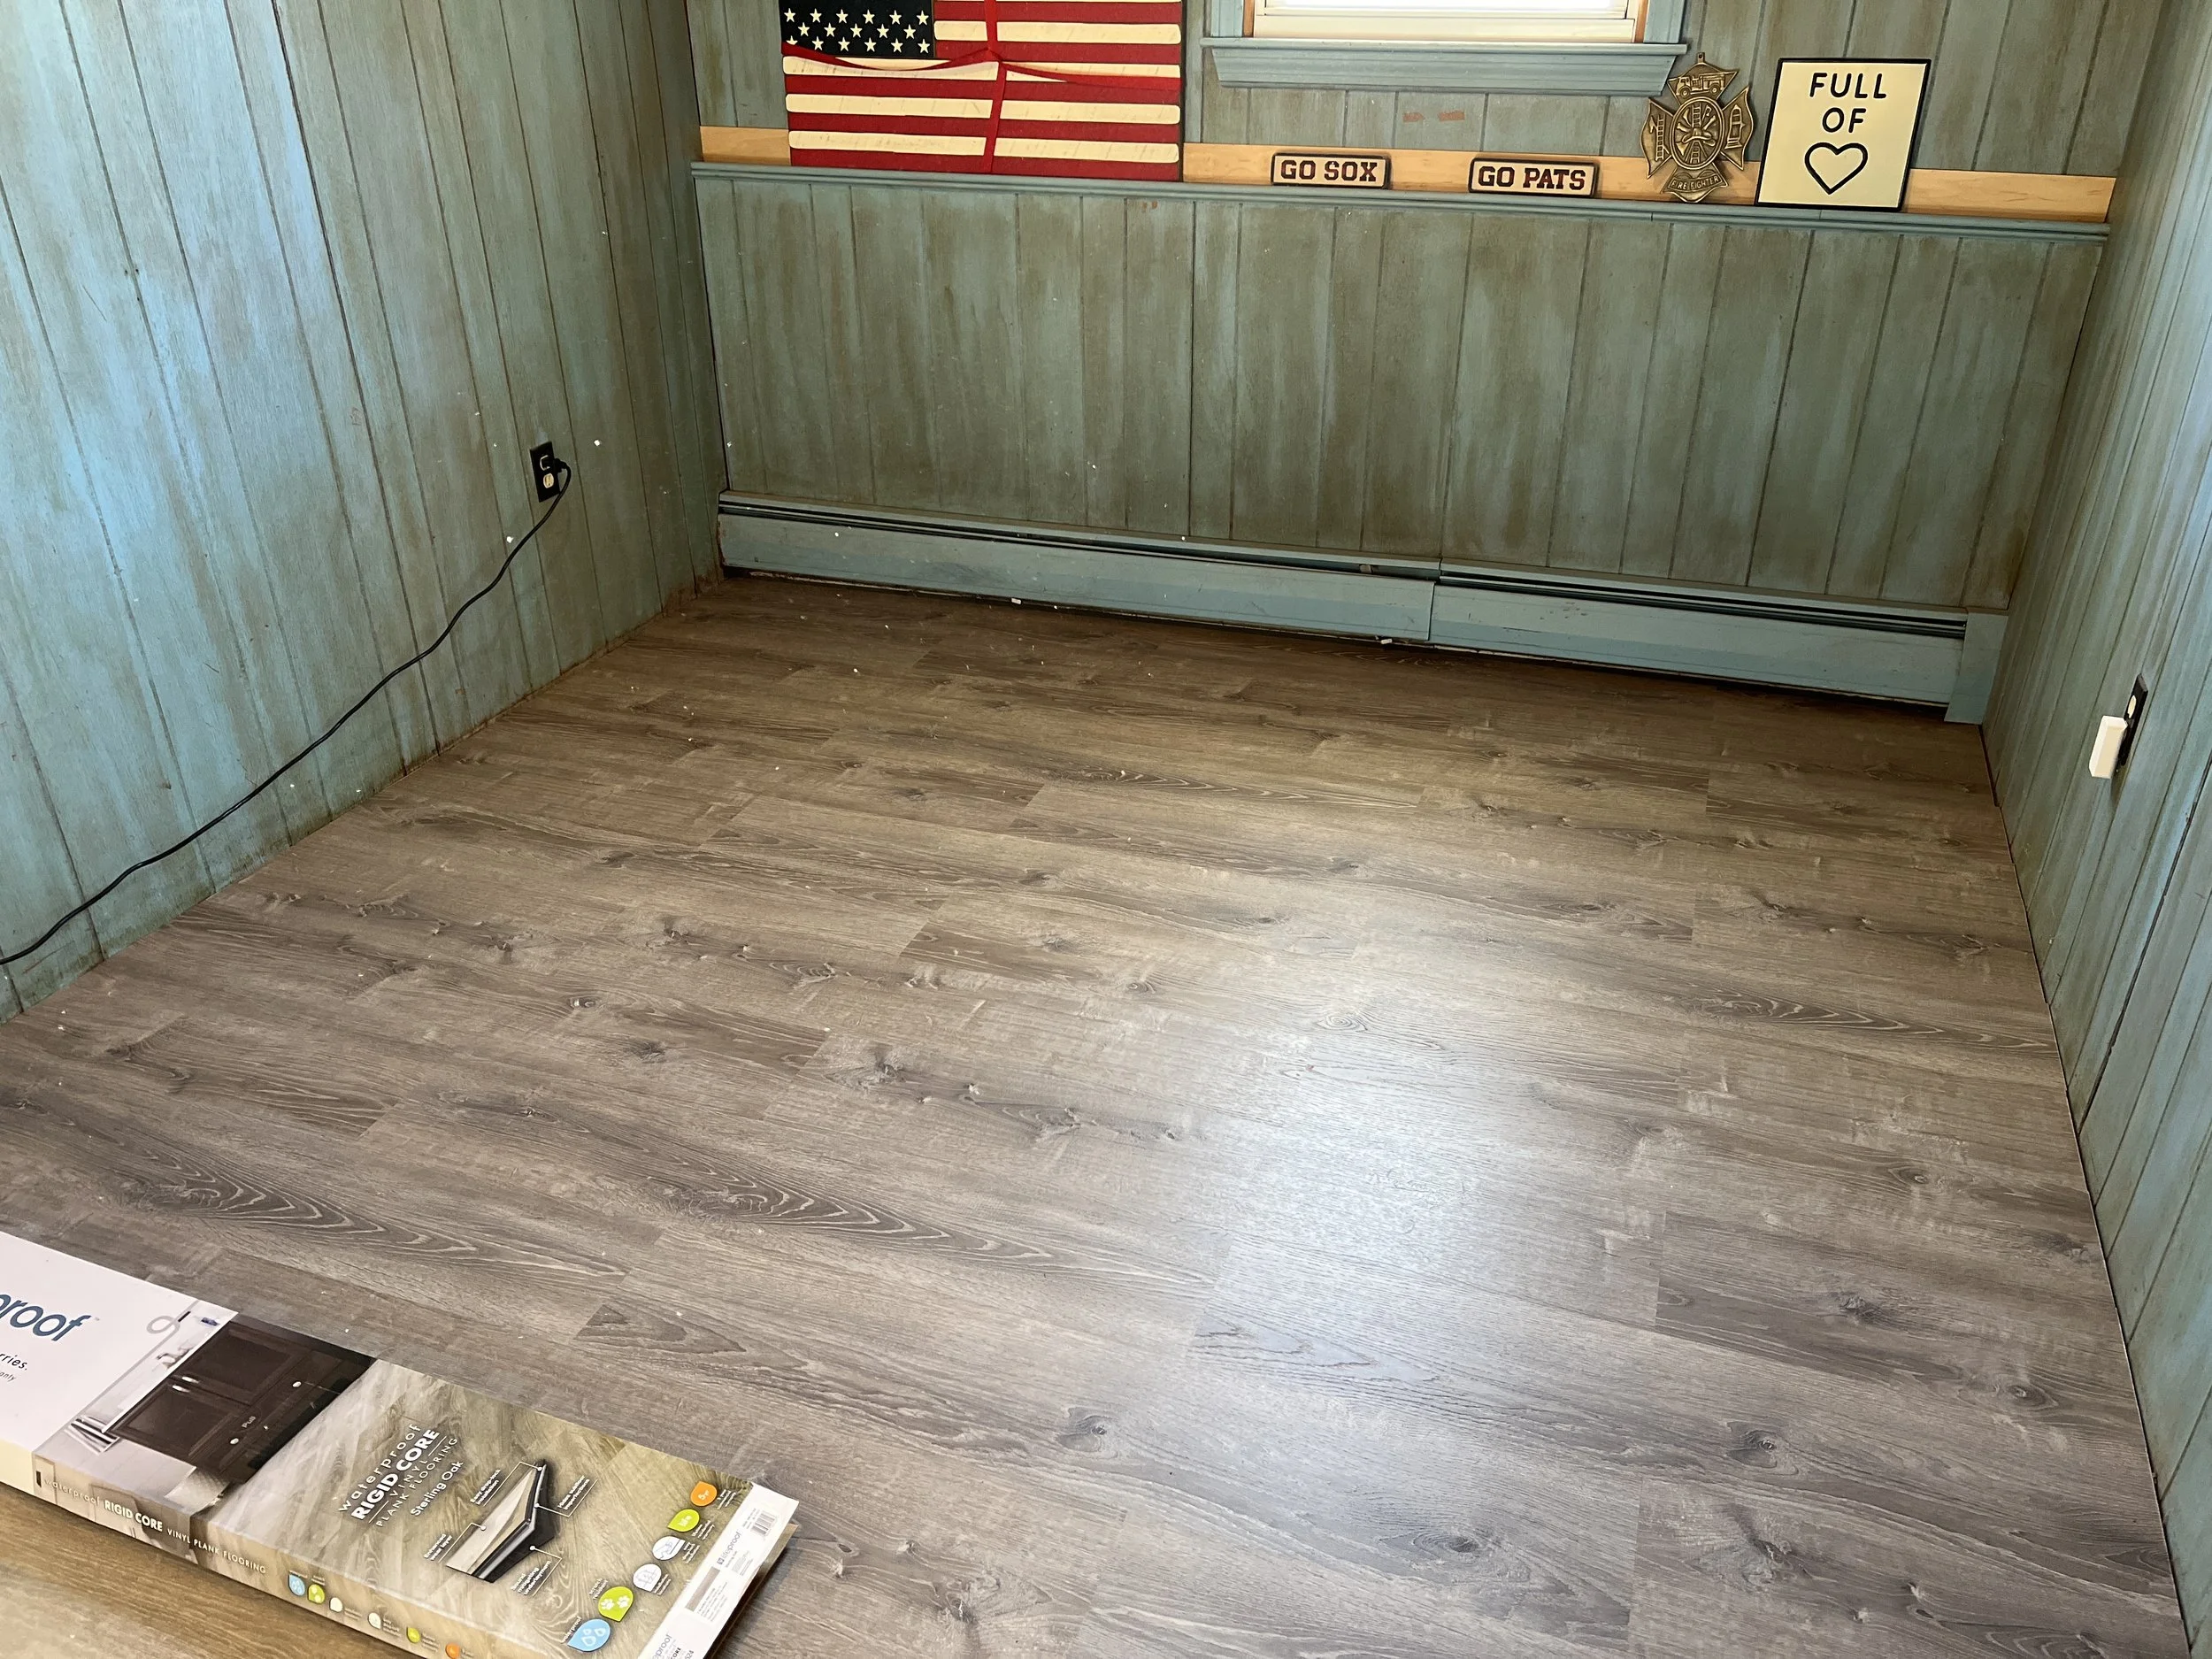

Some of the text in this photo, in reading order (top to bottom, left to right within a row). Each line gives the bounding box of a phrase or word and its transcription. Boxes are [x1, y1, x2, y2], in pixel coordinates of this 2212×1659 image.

[1809, 73, 1886, 99] FULL
[1822, 107, 1867, 134] OF
[1280, 159, 1379, 183] GO SOX
[1478, 165, 1586, 191] GO PATS
[1671, 175, 1719, 190] FIRE FIGHTER
[337, 1423, 422, 1513] waterproof
[351, 1428, 441, 1520] RIGID CORE
[376, 1437, 458, 1527] PLANK FLOORING
[389, 1459, 428, 1498] VINYL
[410, 1461, 464, 1517] Sterling Oak
[44, 1479, 100, 1505] waterproof
[104, 1499, 134, 1519] RIGID
[134, 1512, 163, 1532] CORE
[167, 1527, 190, 1544] VINYL
[193, 1539, 219, 1555] PLANK
[223, 1550, 266, 1574] FLOORING
